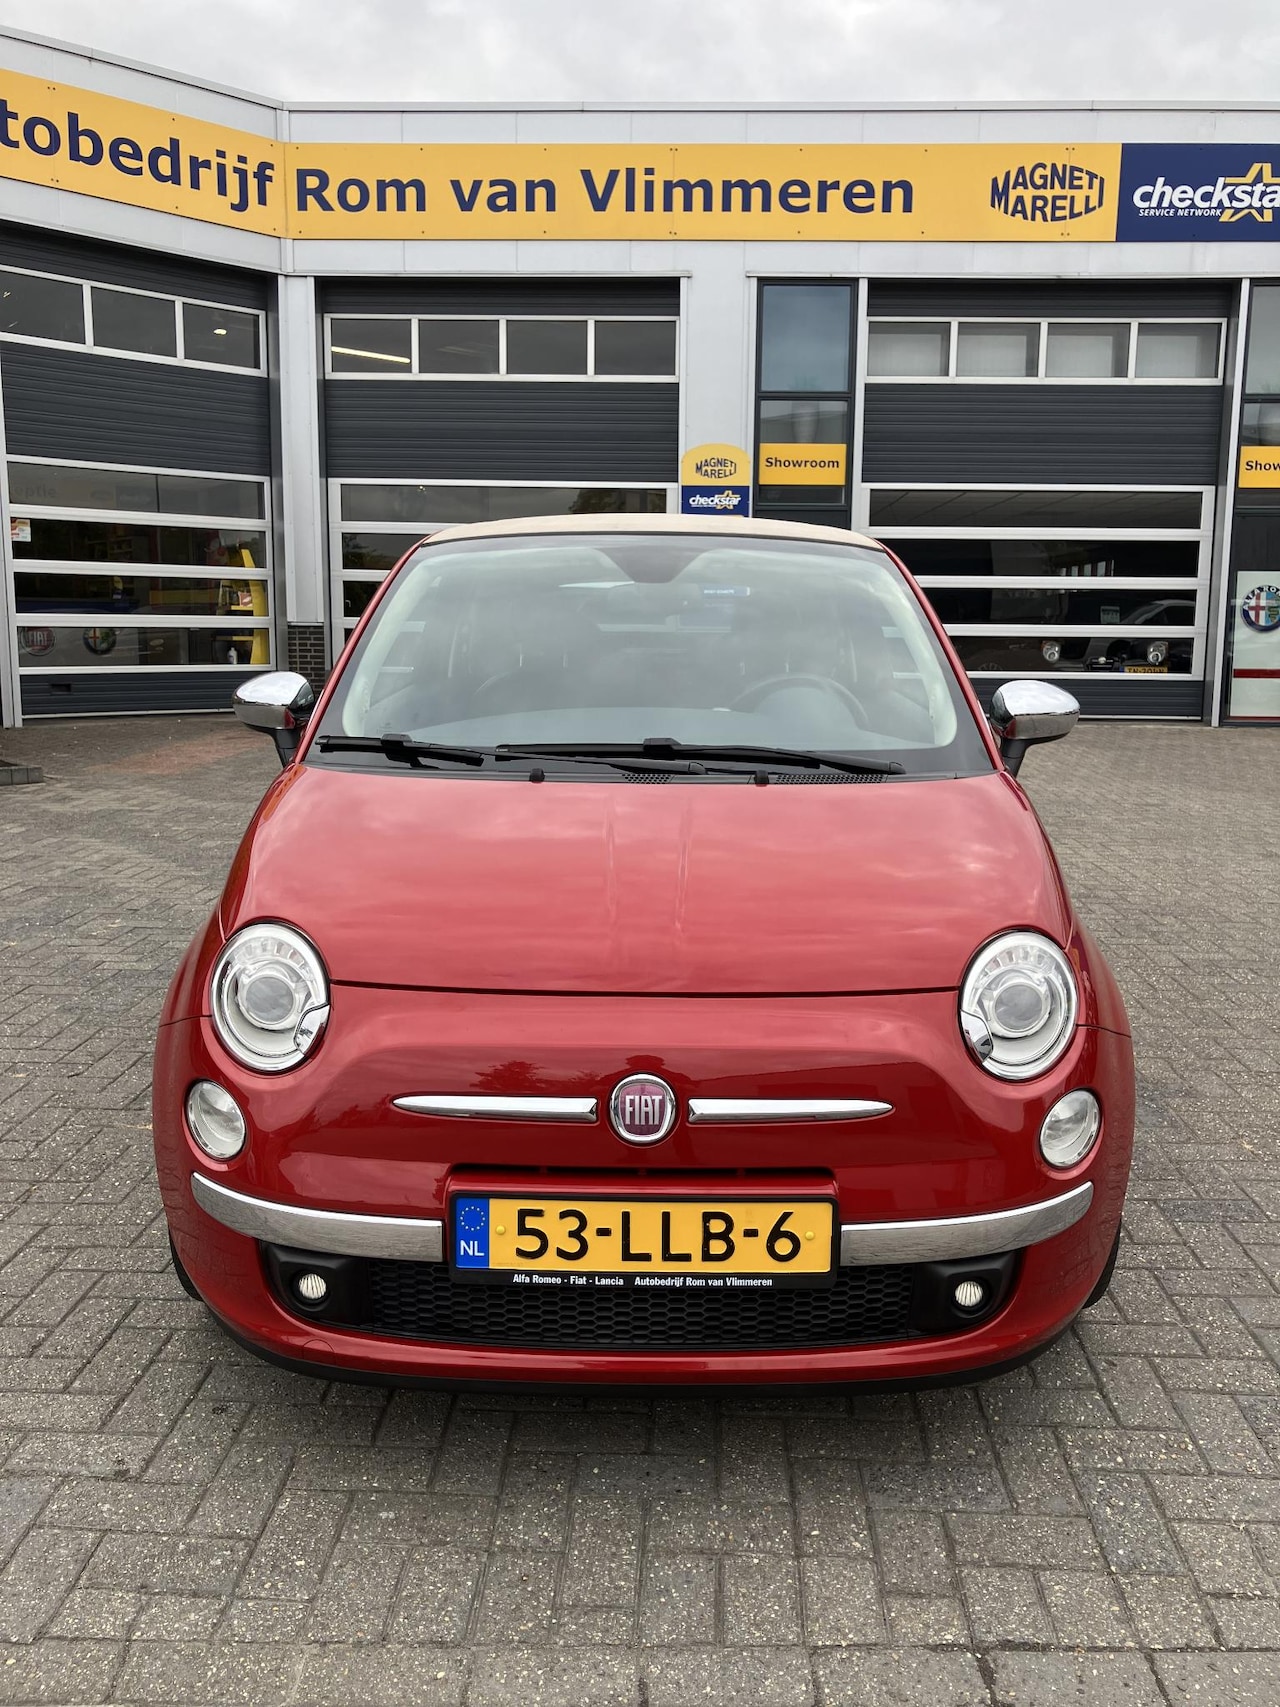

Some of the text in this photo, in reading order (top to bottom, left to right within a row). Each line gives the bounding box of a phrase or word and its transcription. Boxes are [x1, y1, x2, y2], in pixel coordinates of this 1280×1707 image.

[0, 98, 275, 213] tobedrijf
[295, 167, 914, 214] Rom van Vlimmeren
[1138, 208, 1222, 217] SERVICE NETWORK
[765, 456, 840, 469] Showroom
[689, 494, 742, 505] checkstar
[28, 630, 48, 647] FIAT
[625, 1094, 663, 1125] FIAT
[515, 1208, 801, 1262] 53-LLB-6
[460, 1239, 485, 1257] NL
[513, 1274, 530, 1283] Alfa
[532, 1275, 562, 1284] Romeo
[570, 1275, 587, 1285] Fiat
[595, 1276, 624, 1286] Lancia
[634, 1276, 773, 1288] Autobedrijf Rom van Vlimmeren
